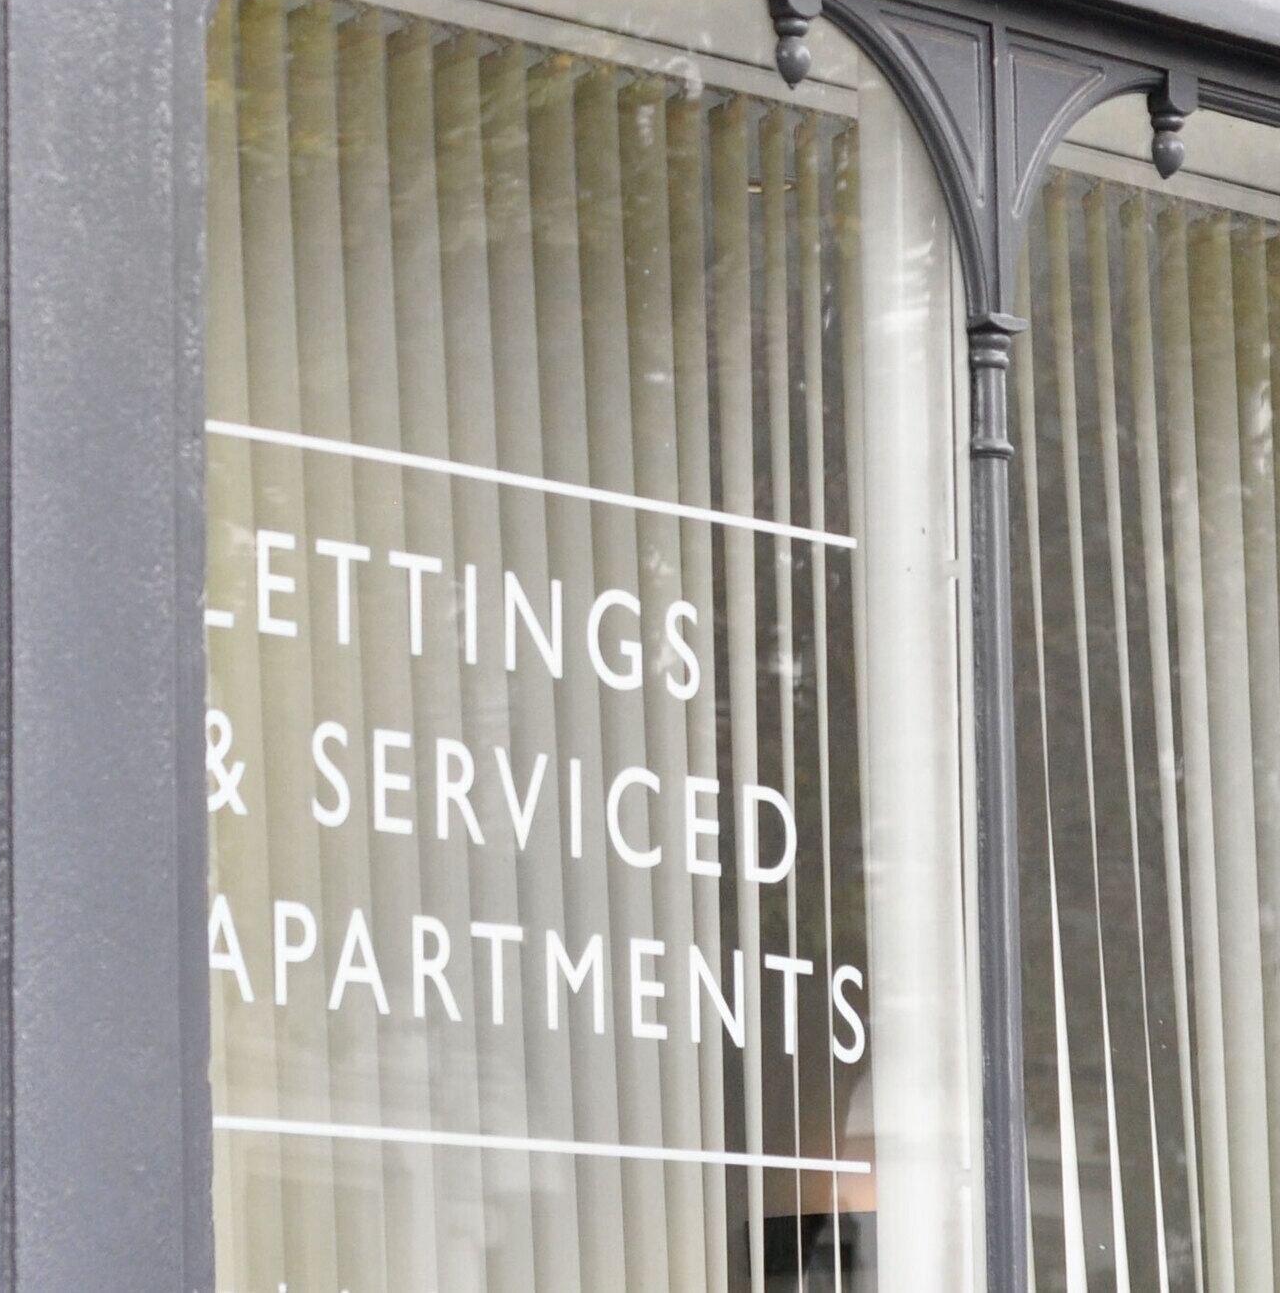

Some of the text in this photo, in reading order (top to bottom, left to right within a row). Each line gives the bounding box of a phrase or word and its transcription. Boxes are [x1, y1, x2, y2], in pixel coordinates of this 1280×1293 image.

[205, 529, 701, 701] ETTINGS
[205, 708, 798, 885] & SERVICED
[206, 893, 867, 1065] APARTMENTS
